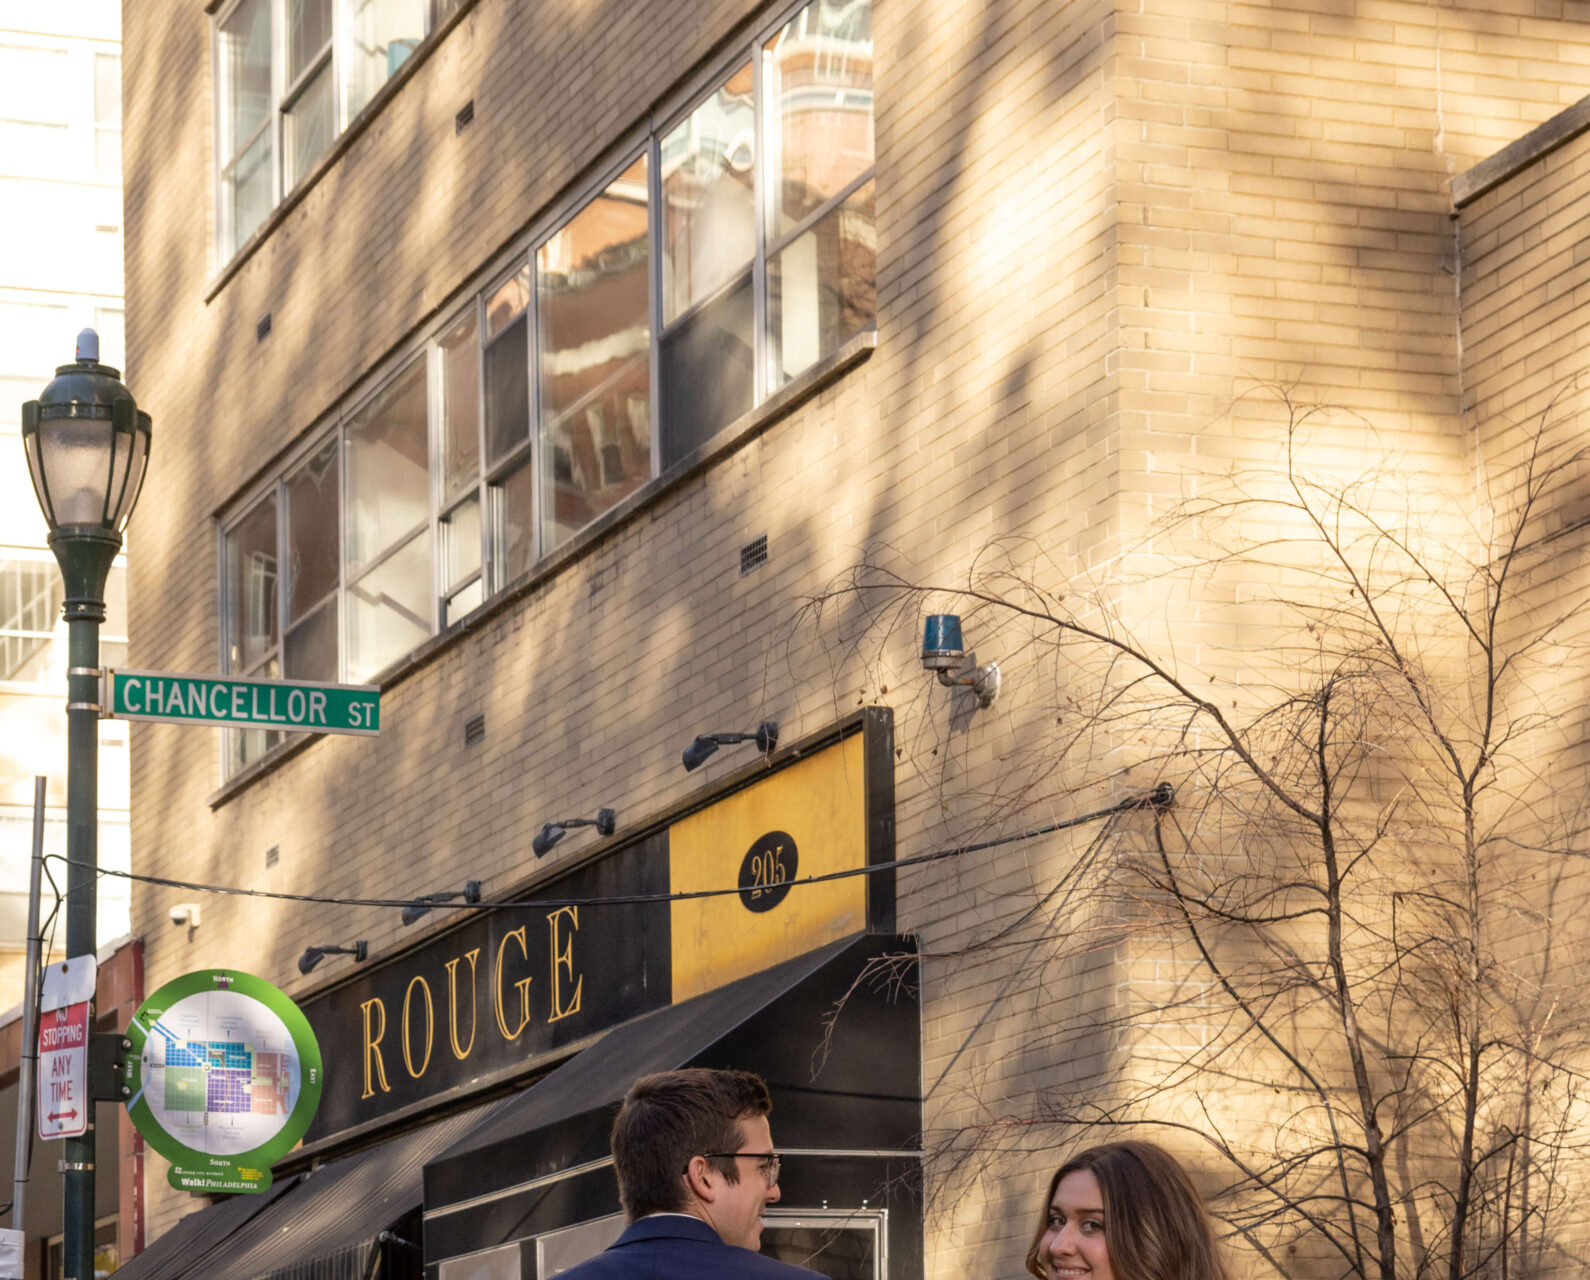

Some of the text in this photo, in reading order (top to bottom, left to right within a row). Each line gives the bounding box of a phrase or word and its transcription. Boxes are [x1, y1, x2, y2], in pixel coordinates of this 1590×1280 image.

[123, 678, 375, 728] CHANCELLOR ST
[751, 844, 786, 900] 205
[359, 904, 584, 1101] ROUGE
[55, 1008, 68, 1023] NO
[42, 1023, 83, 1047] STOPPING
[51, 1054, 72, 1078] ANY
[50, 1079, 73, 1103] TIME
